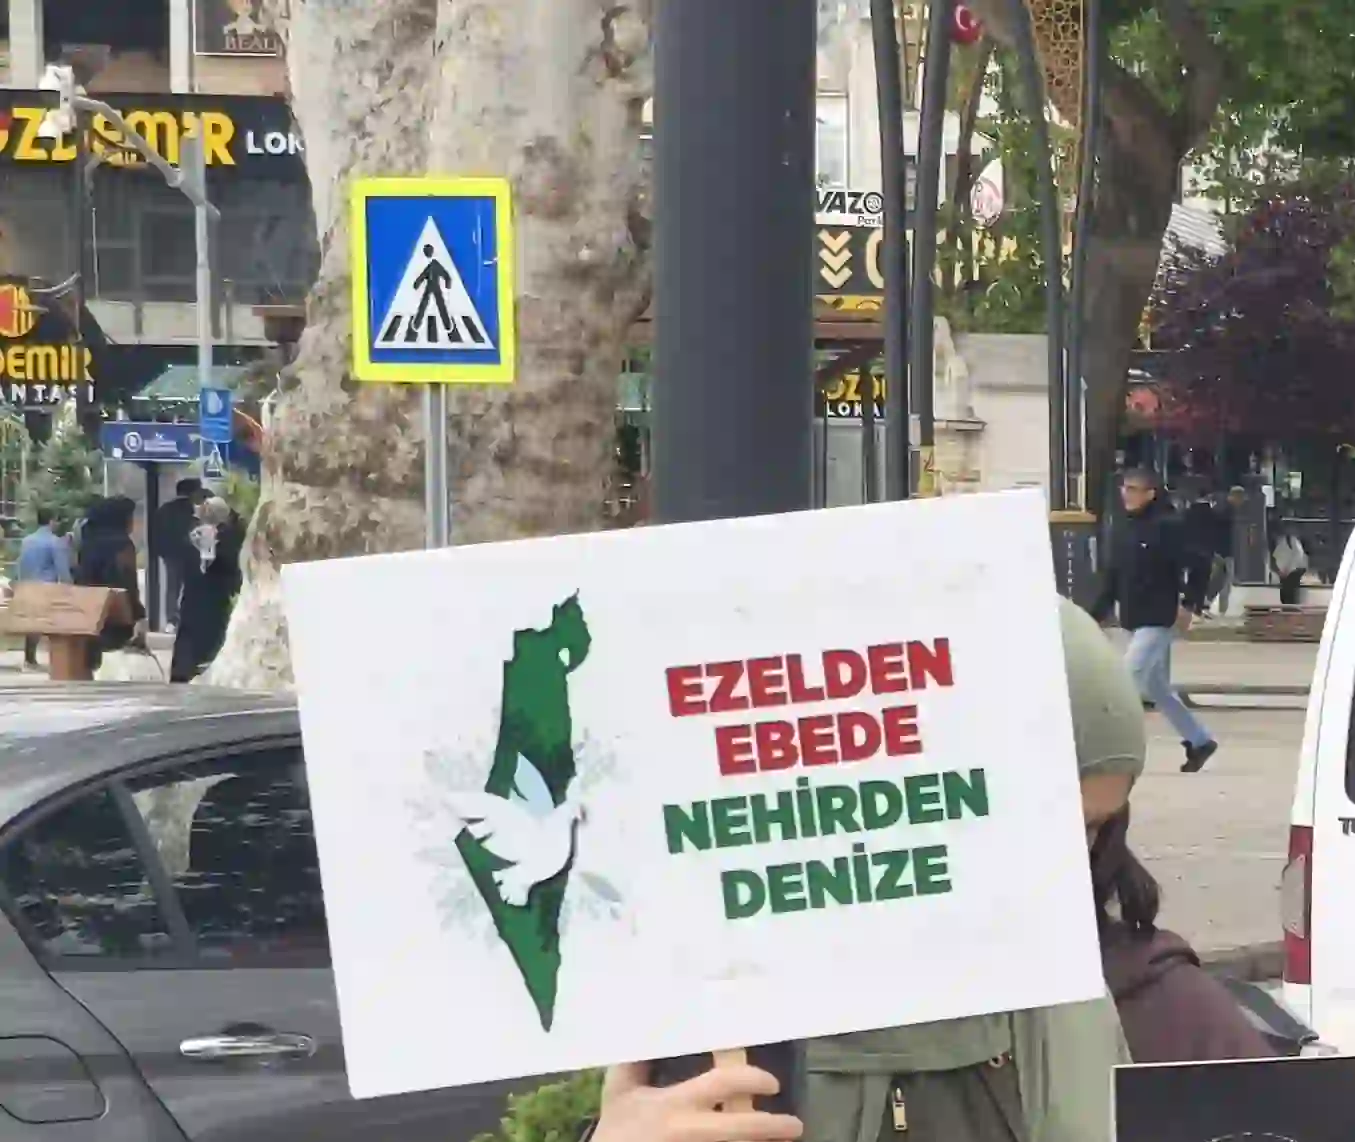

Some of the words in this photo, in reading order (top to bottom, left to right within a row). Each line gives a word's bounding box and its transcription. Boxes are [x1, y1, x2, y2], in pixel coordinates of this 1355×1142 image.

[665, 637, 954, 718] EZELDEN
[715, 704, 923, 776] EBEDE
[663, 768, 989, 854] NEHİRDEN
[720, 842, 952, 919] DENİZE
